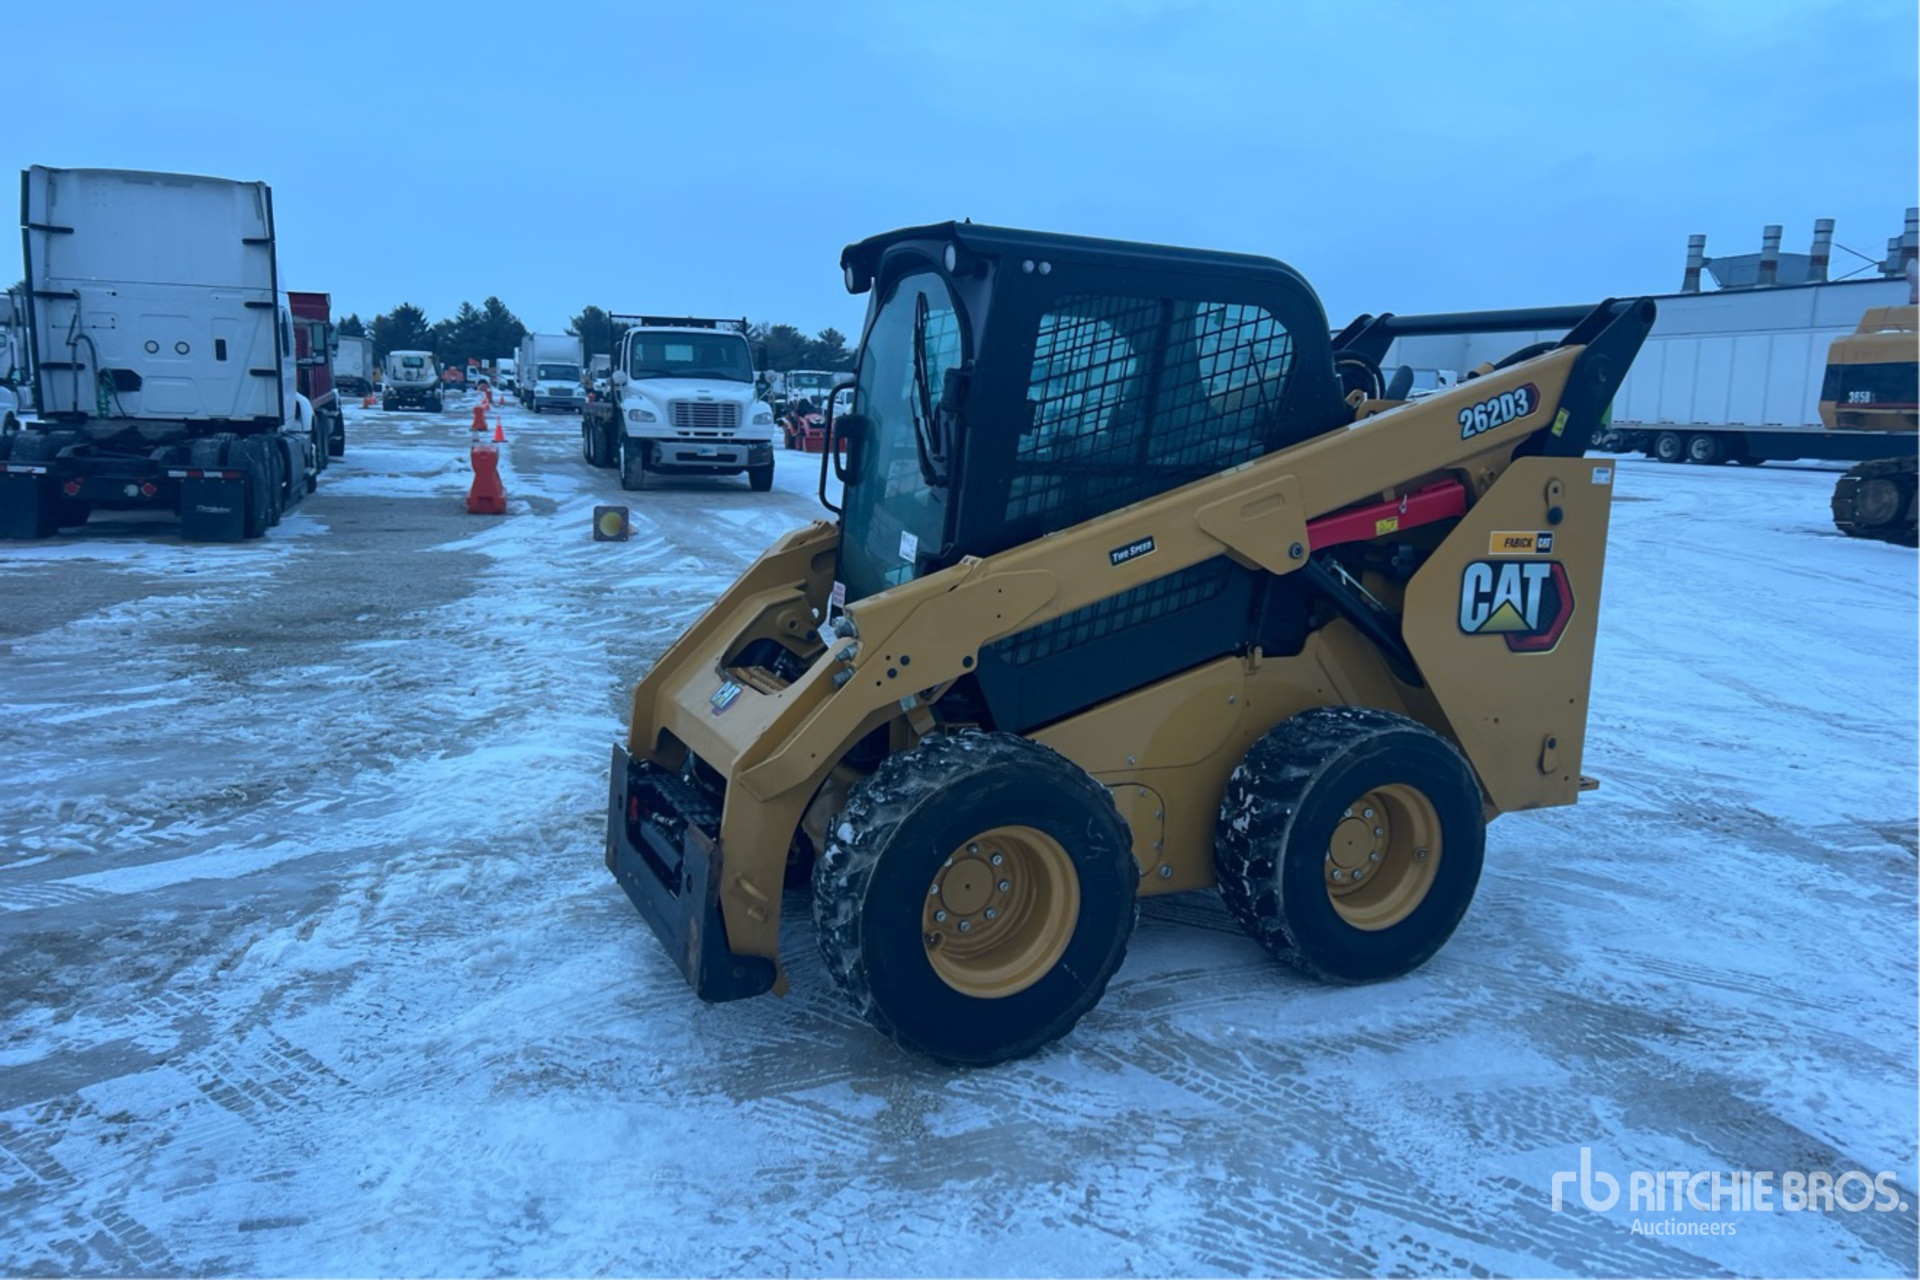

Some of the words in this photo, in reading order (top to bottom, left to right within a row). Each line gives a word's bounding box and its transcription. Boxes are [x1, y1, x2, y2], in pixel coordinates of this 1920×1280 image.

[1459, 387, 1531, 439] 262D3
[1503, 537, 1534, 548] FABICK
[1537, 537, 1552, 548] CAT
[1460, 562, 1551, 633] CAT
